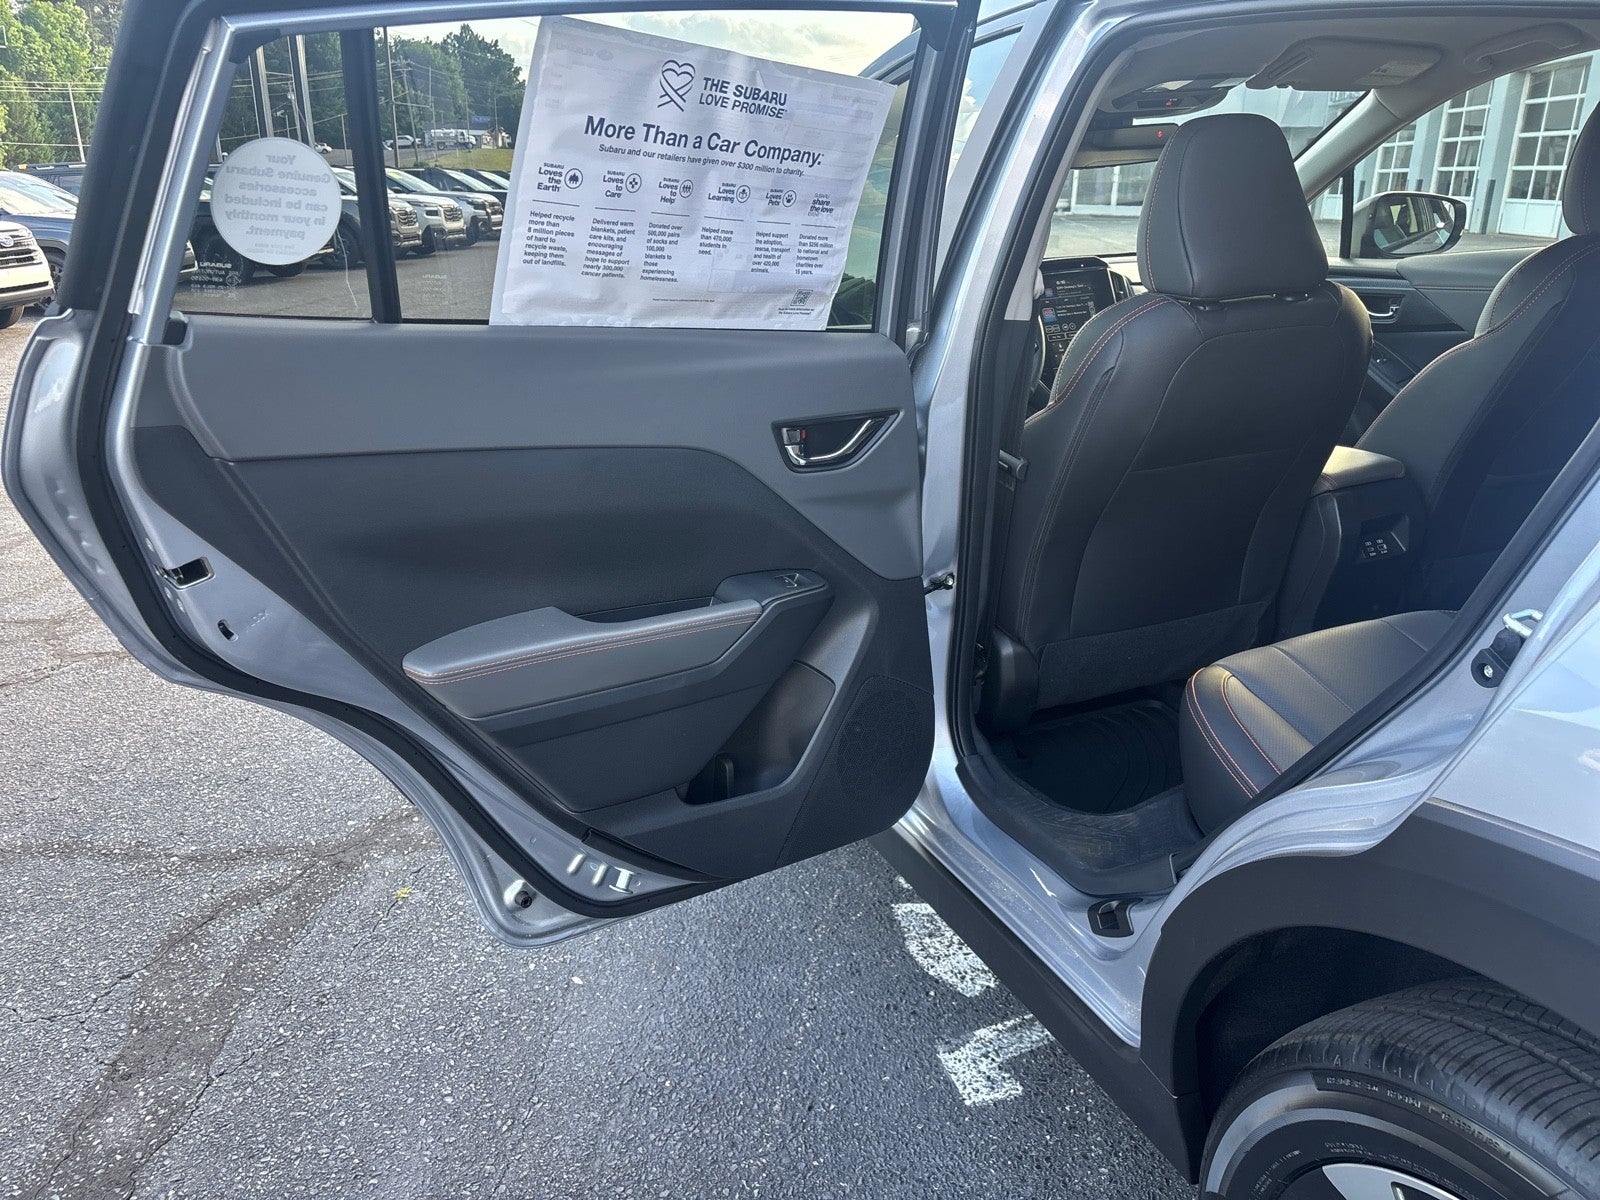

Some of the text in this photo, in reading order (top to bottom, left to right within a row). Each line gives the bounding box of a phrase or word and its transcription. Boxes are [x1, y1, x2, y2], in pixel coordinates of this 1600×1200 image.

[703, 77, 787, 106] THE SUBARU
[699, 93, 729, 108] LOVE
[584, 116, 635, 140] More
[643, 123, 688, 148] Than
[693, 136, 701, 150] a
[707, 132, 740, 154] Car
[599, 144, 625, 154] Subaru
[657, 153, 685, 163] retailers
[702, 157, 719, 166] given
[737, 162, 753, 170] $300
[783, 168, 804, 177] charity.
[538, 167, 563, 177] Loves
[548, 176, 561, 184] the
[603, 175, 624, 184] Loves
[537, 183, 560, 192] Earth
[658, 181, 678, 190] Loves
[605, 190, 622, 198] Care
[708, 193, 734, 203] Learning
[660, 195, 675, 205] Help
[530, 211, 575, 222] Helped recycle
[592, 218, 618, 227] Delivered
[591, 226, 616, 234] blankets,
[525, 242, 547, 250] recycle
[587, 241, 624, 250] encouraging
